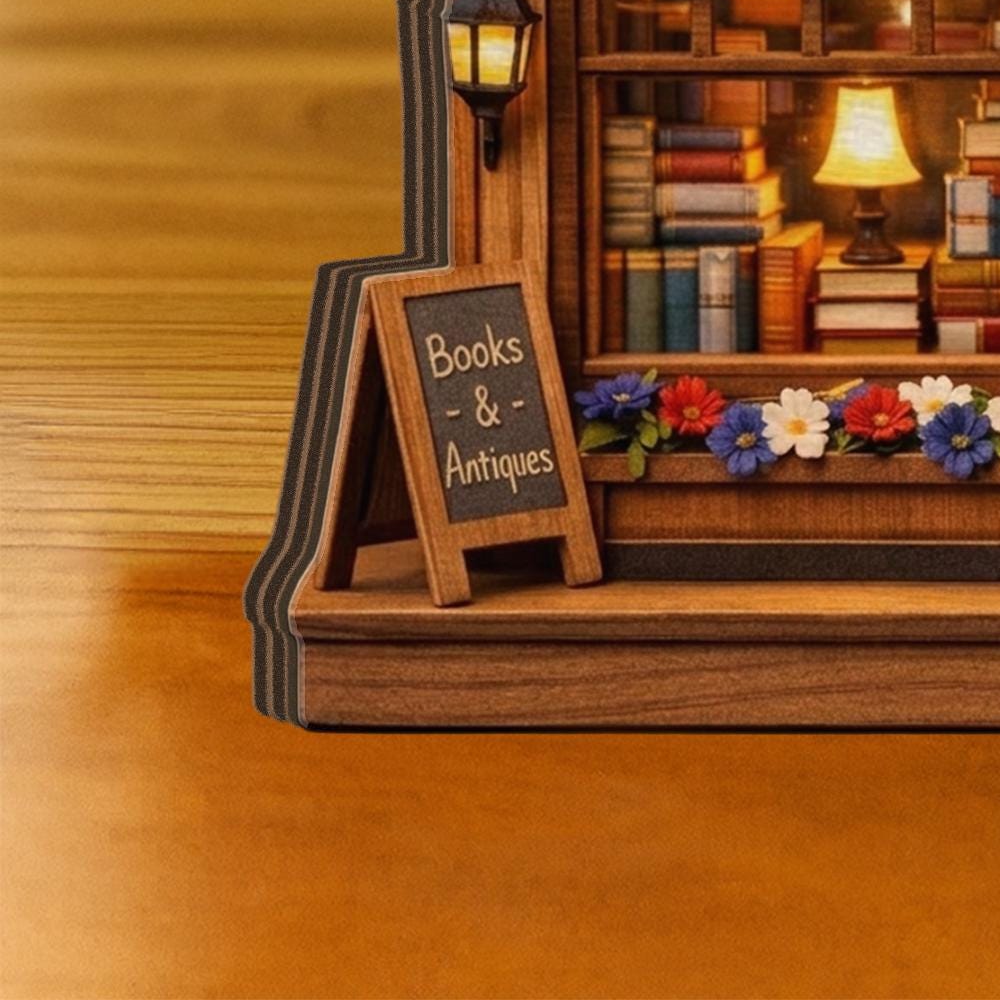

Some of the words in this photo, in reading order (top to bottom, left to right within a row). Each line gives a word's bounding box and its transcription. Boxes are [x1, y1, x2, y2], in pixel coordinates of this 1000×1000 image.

[425, 323, 524, 379] Books
[474, 385, 501, 427] &
[445, 440, 554, 494] Antiques
